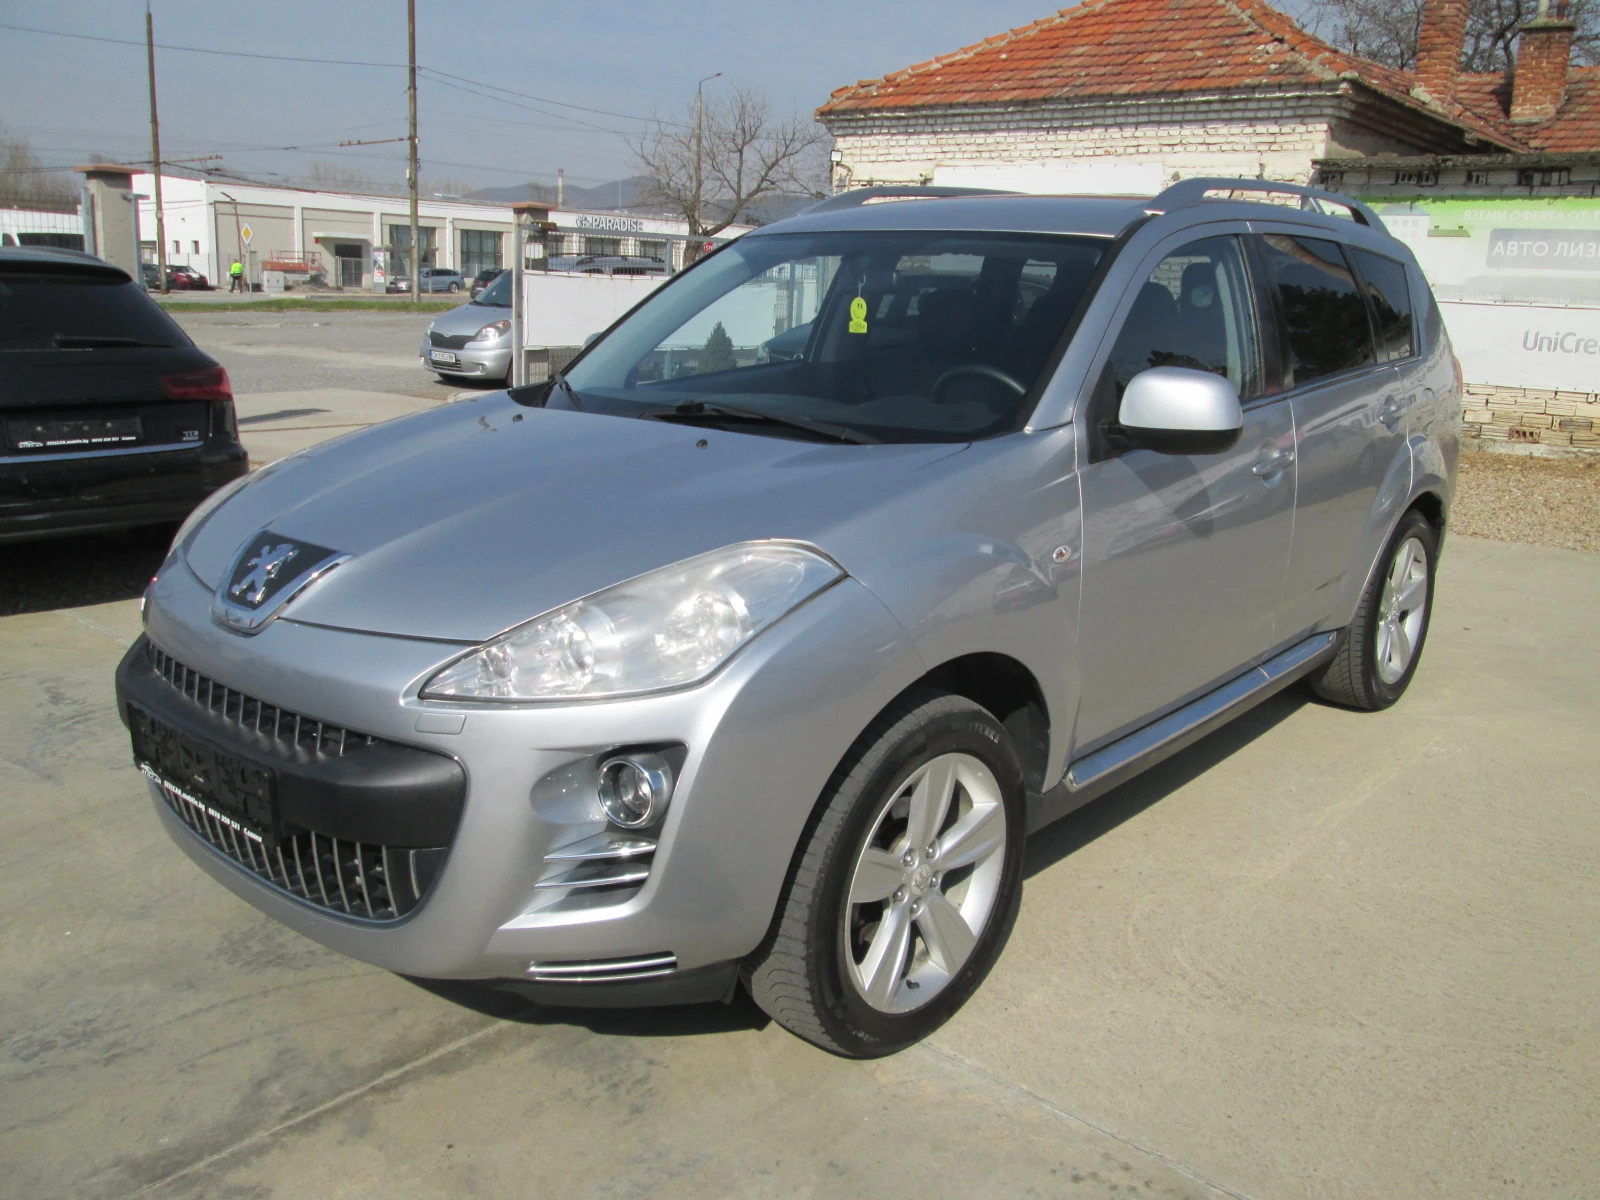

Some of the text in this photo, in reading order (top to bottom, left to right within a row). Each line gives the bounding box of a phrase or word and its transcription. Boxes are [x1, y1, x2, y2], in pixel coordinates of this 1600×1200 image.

[592, 215, 644, 232] PARADISE
[1464, 210, 1506, 221] ВЗЕМИ
[1510, 210, 1564, 221] ОФЕРТА
[1568, 211, 1589, 221] ОТ
[1491, 241, 1549, 257] АВТО
[1522, 329, 1600, 355] UniCre
